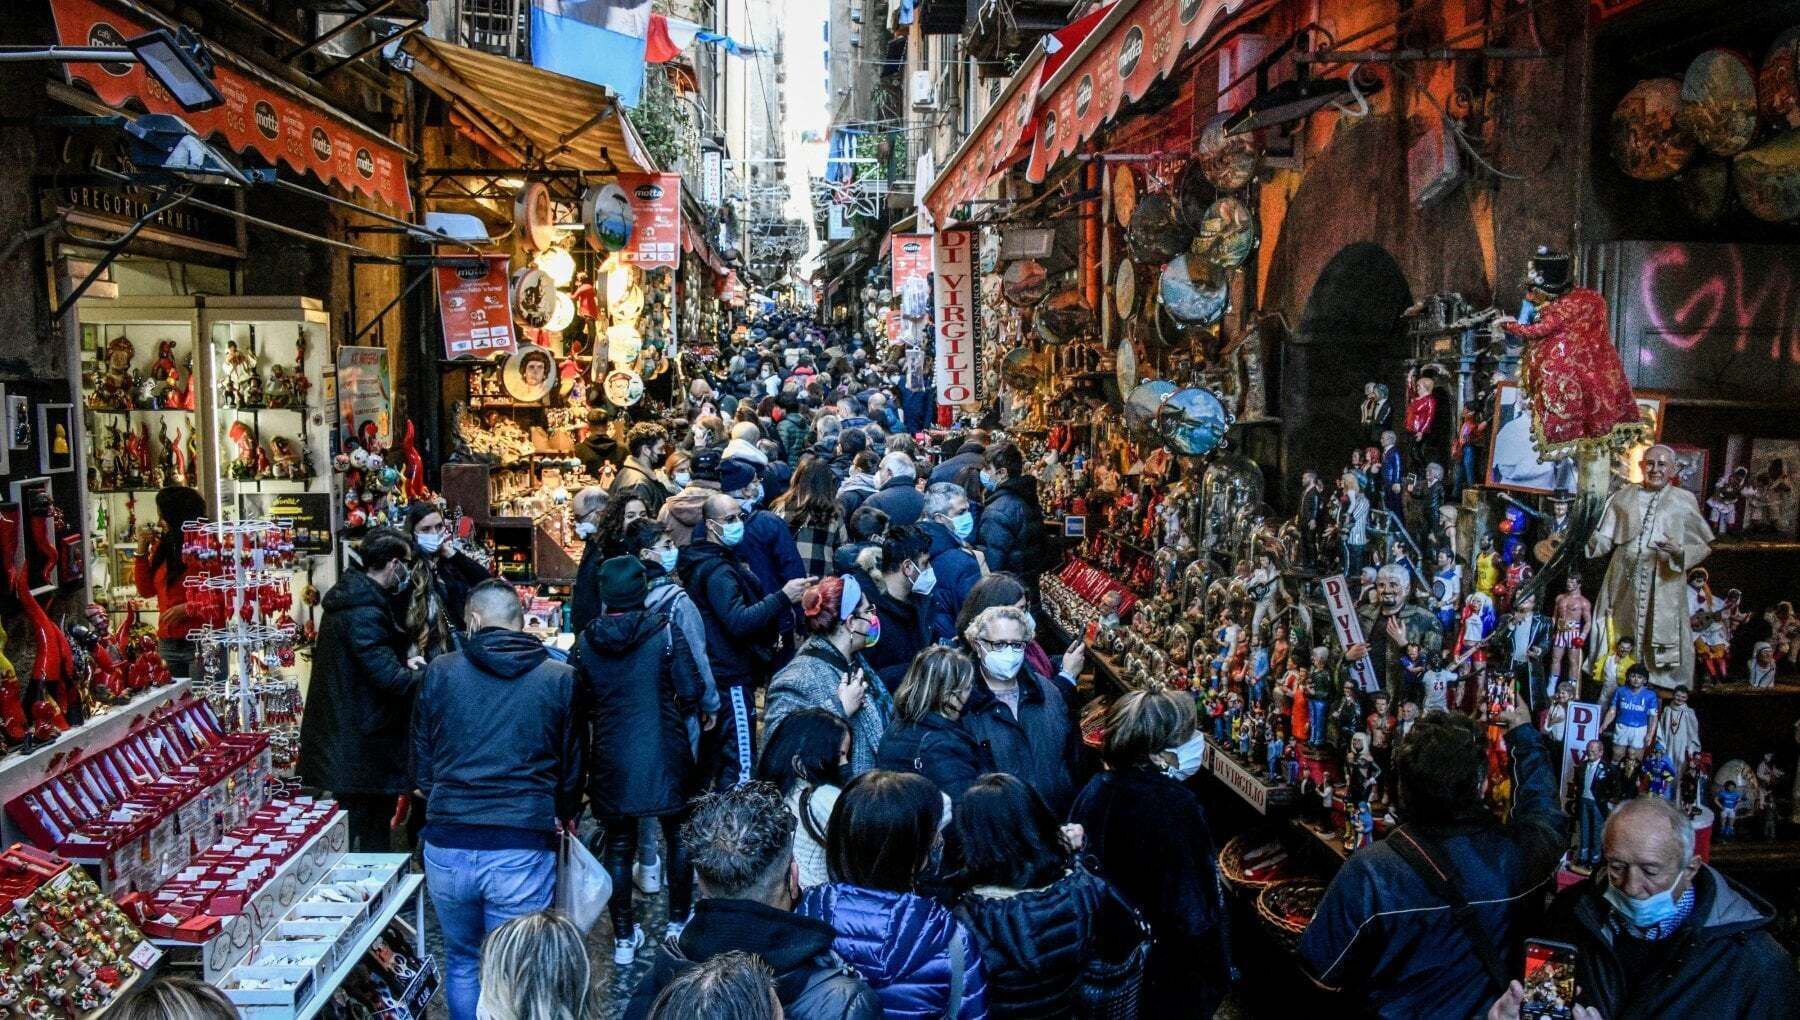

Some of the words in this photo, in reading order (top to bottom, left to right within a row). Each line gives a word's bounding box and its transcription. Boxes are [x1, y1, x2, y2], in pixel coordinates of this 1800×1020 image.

[1120, 38, 1142, 67] motta
[256, 111, 279, 134] motta
[312, 137, 332, 156] motta
[357, 157, 374, 174] motta
[71, 187, 147, 219] GREGORIO
[635, 188, 663, 198] motta
[940, 231, 966, 263] DI
[973, 284, 982, 340] GENNARO
[939, 275, 970, 402] VIRGILIO
[975, 352, 984, 400] ROSARIO
[1327, 581, 1342, 609] DI
[1337, 614, 1368, 692] VIGI
[1573, 707, 1592, 741] DI
[1216, 757, 1223, 774] DI
[1226, 764, 1264, 807] VIRGILIO
